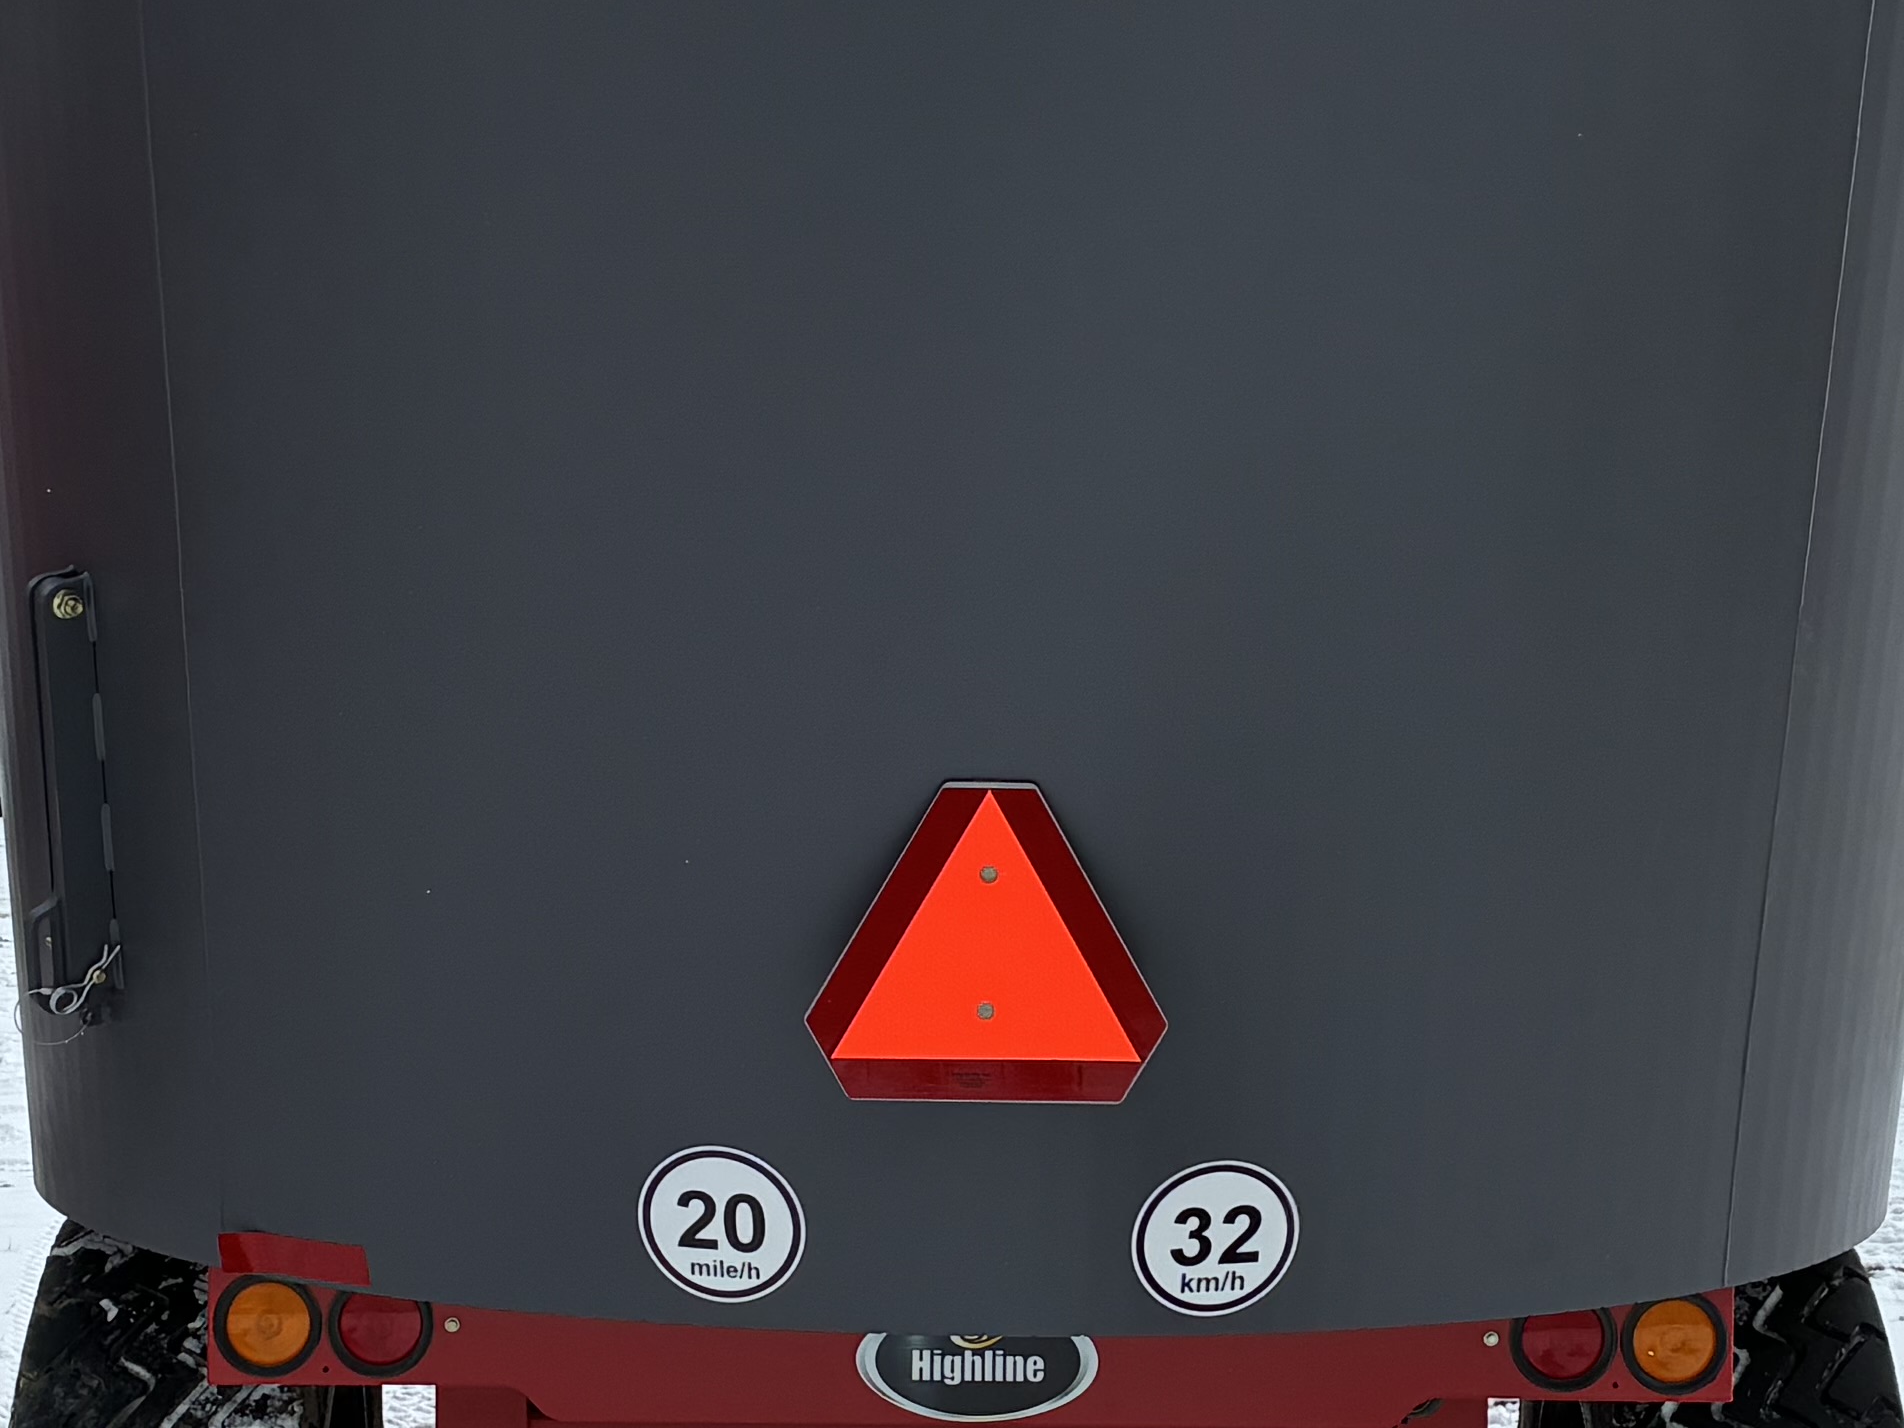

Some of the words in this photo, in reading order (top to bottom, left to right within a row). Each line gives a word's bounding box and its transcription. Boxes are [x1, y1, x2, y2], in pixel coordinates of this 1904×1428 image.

[676, 1189, 766, 1254] 20
[1169, 1204, 1262, 1267] 32
[690, 1259, 761, 1280] mile/h
[1180, 1270, 1245, 1294] km/h
[911, 1349, 1045, 1385] Highline
